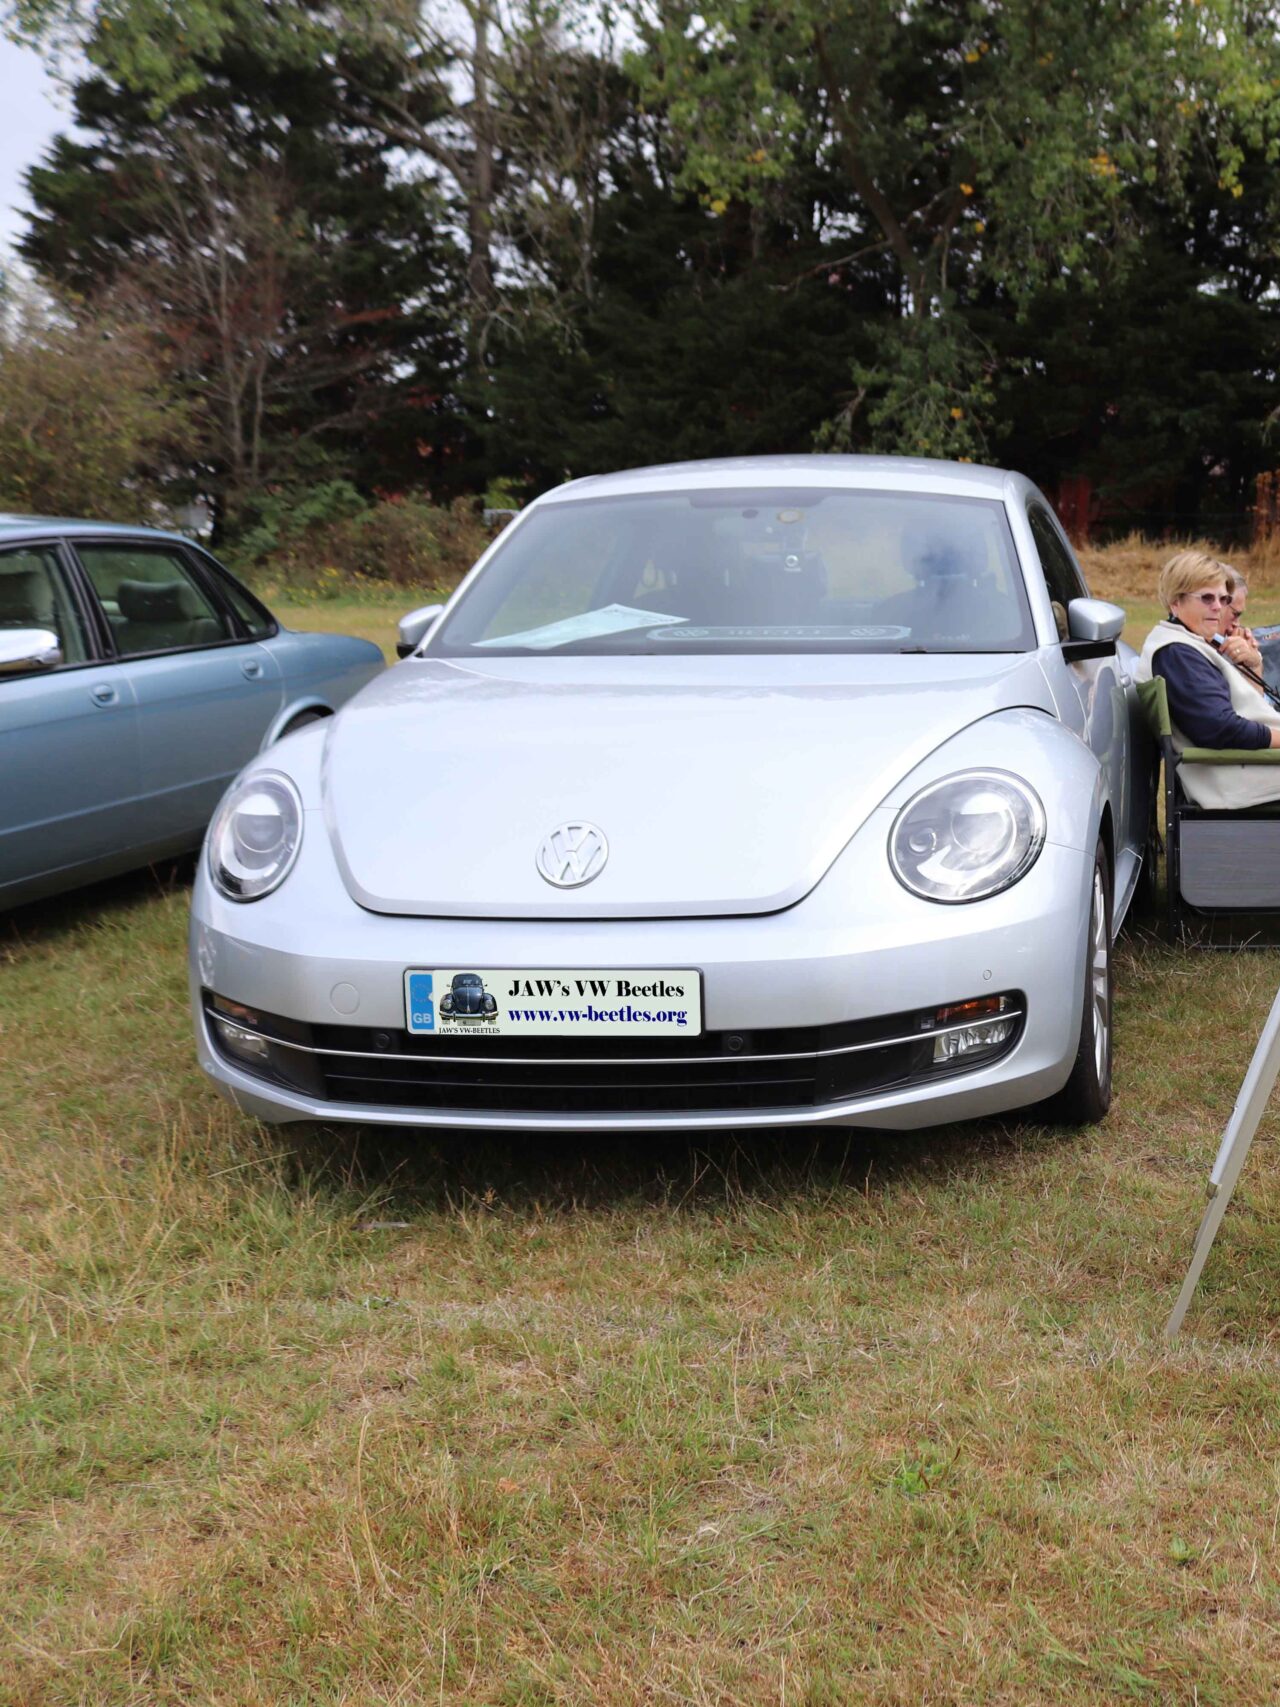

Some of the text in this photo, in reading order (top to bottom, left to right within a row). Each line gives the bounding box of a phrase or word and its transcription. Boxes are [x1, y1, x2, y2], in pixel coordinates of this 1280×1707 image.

[535, 820, 609, 890] VW
[575, 980, 611, 997] VW
[616, 980, 685, 998] Beetles
[412, 1013, 432, 1024] GB
[508, 1005, 688, 1027] www.vw-beetles.org
